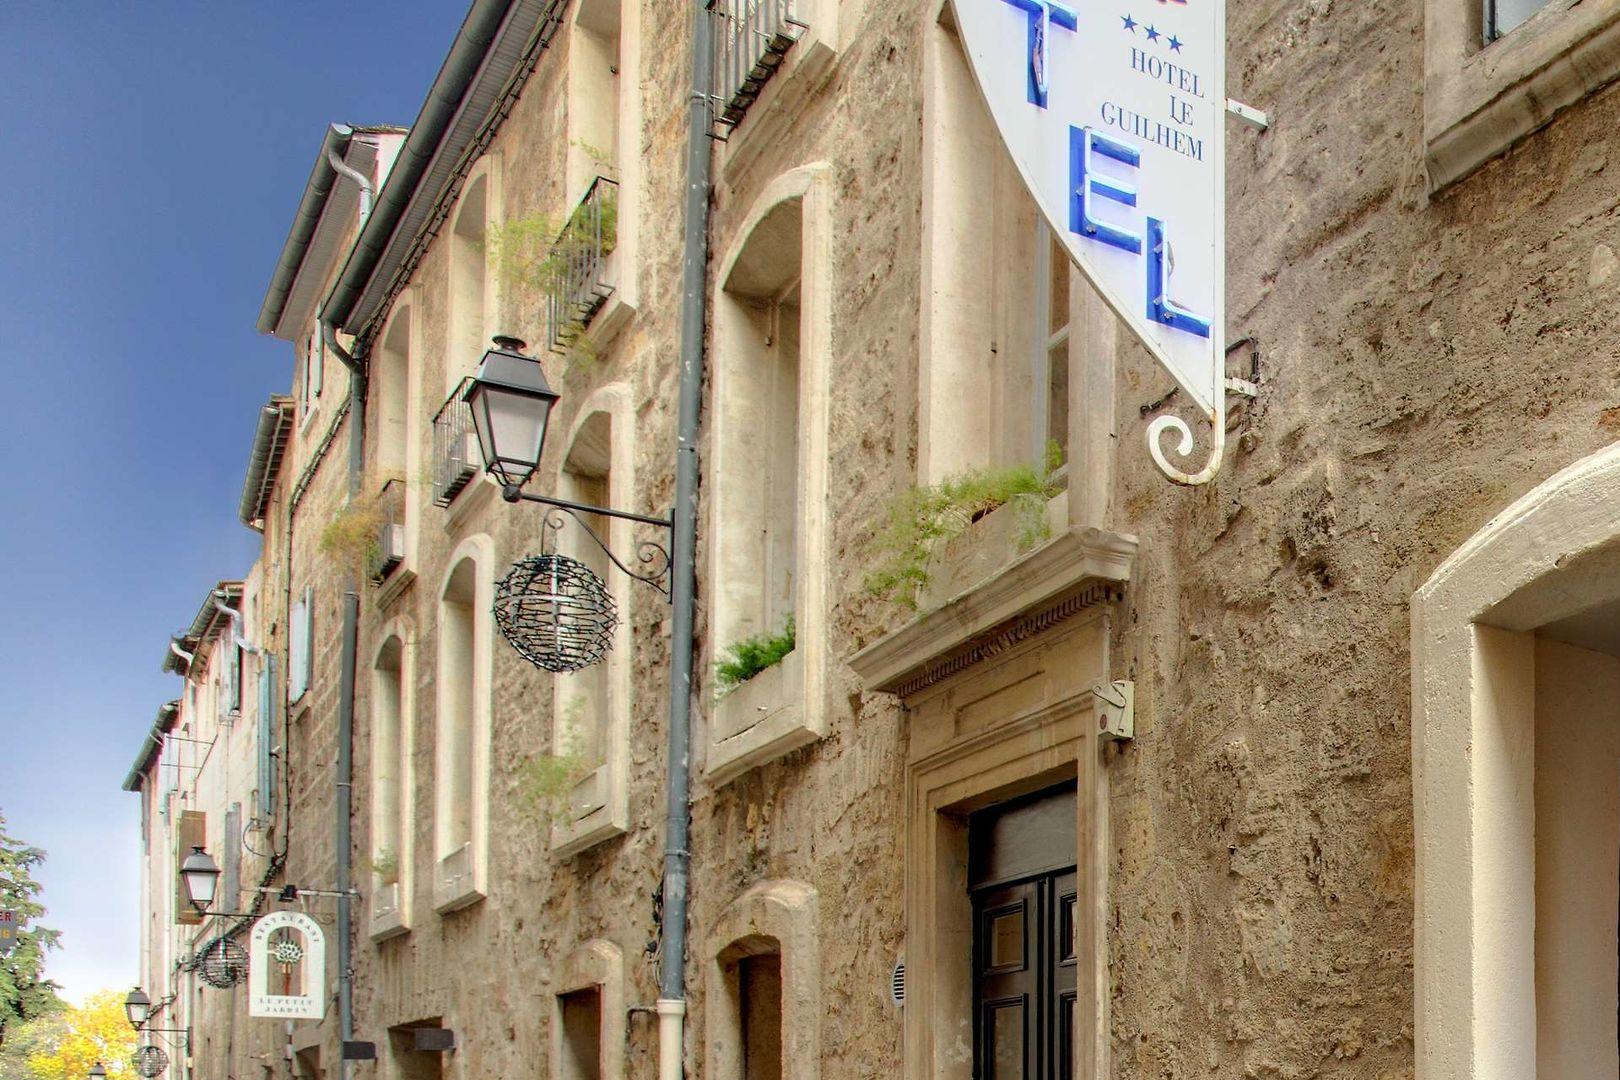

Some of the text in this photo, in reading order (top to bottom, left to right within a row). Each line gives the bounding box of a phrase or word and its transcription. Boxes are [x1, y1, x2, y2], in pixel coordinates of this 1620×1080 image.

[1130, 47, 1205, 99] HOTEL
[1100, 101, 1204, 162] GUILHEM
[1168, 94, 1194, 127] LE
